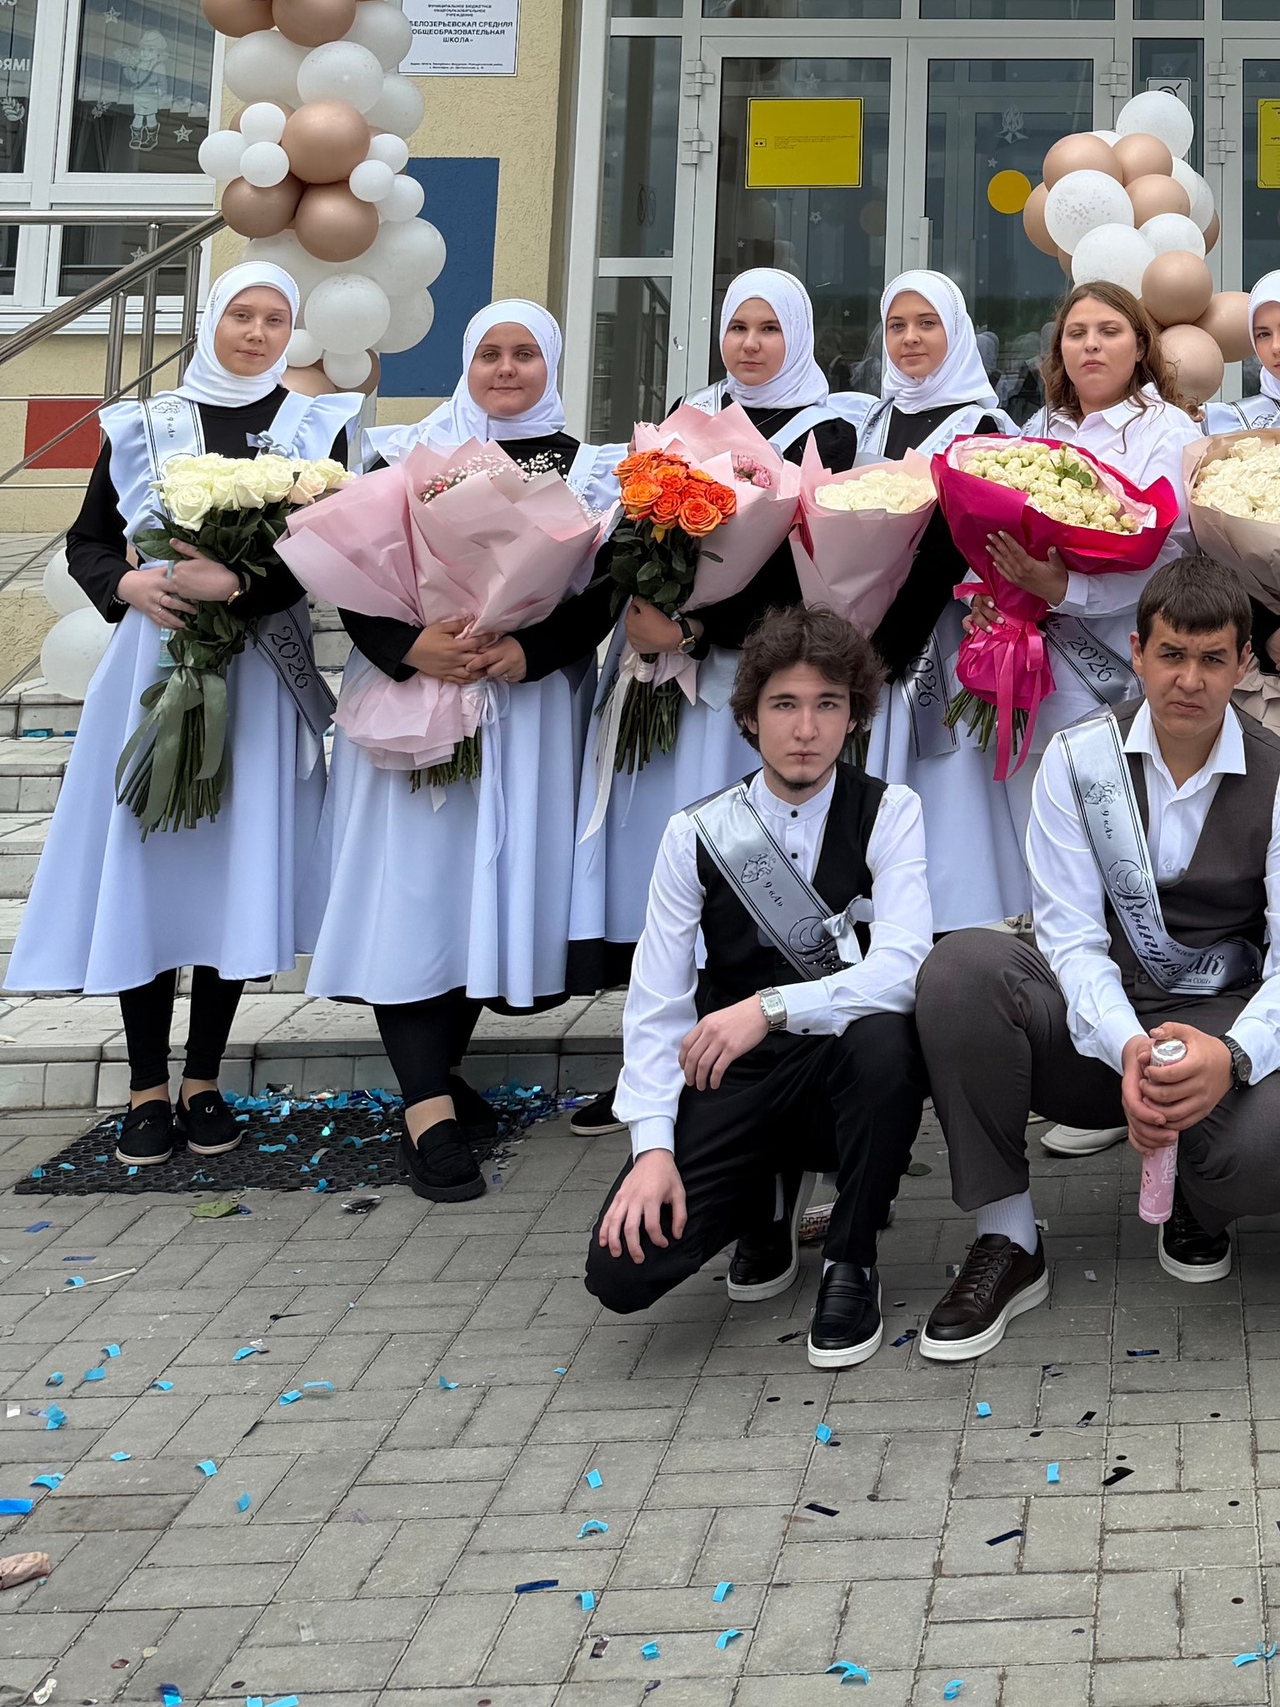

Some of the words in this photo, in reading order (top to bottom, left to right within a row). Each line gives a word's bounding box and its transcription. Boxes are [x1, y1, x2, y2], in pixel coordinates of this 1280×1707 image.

[411, 28, 505, 36] ОБЩЕОБРАЗОВАТЕЛЬНАЯ
[267, 625, 312, 689] 2026
[1067, 636, 1120, 683] 2026
[762, 881, 772, 890] 9
